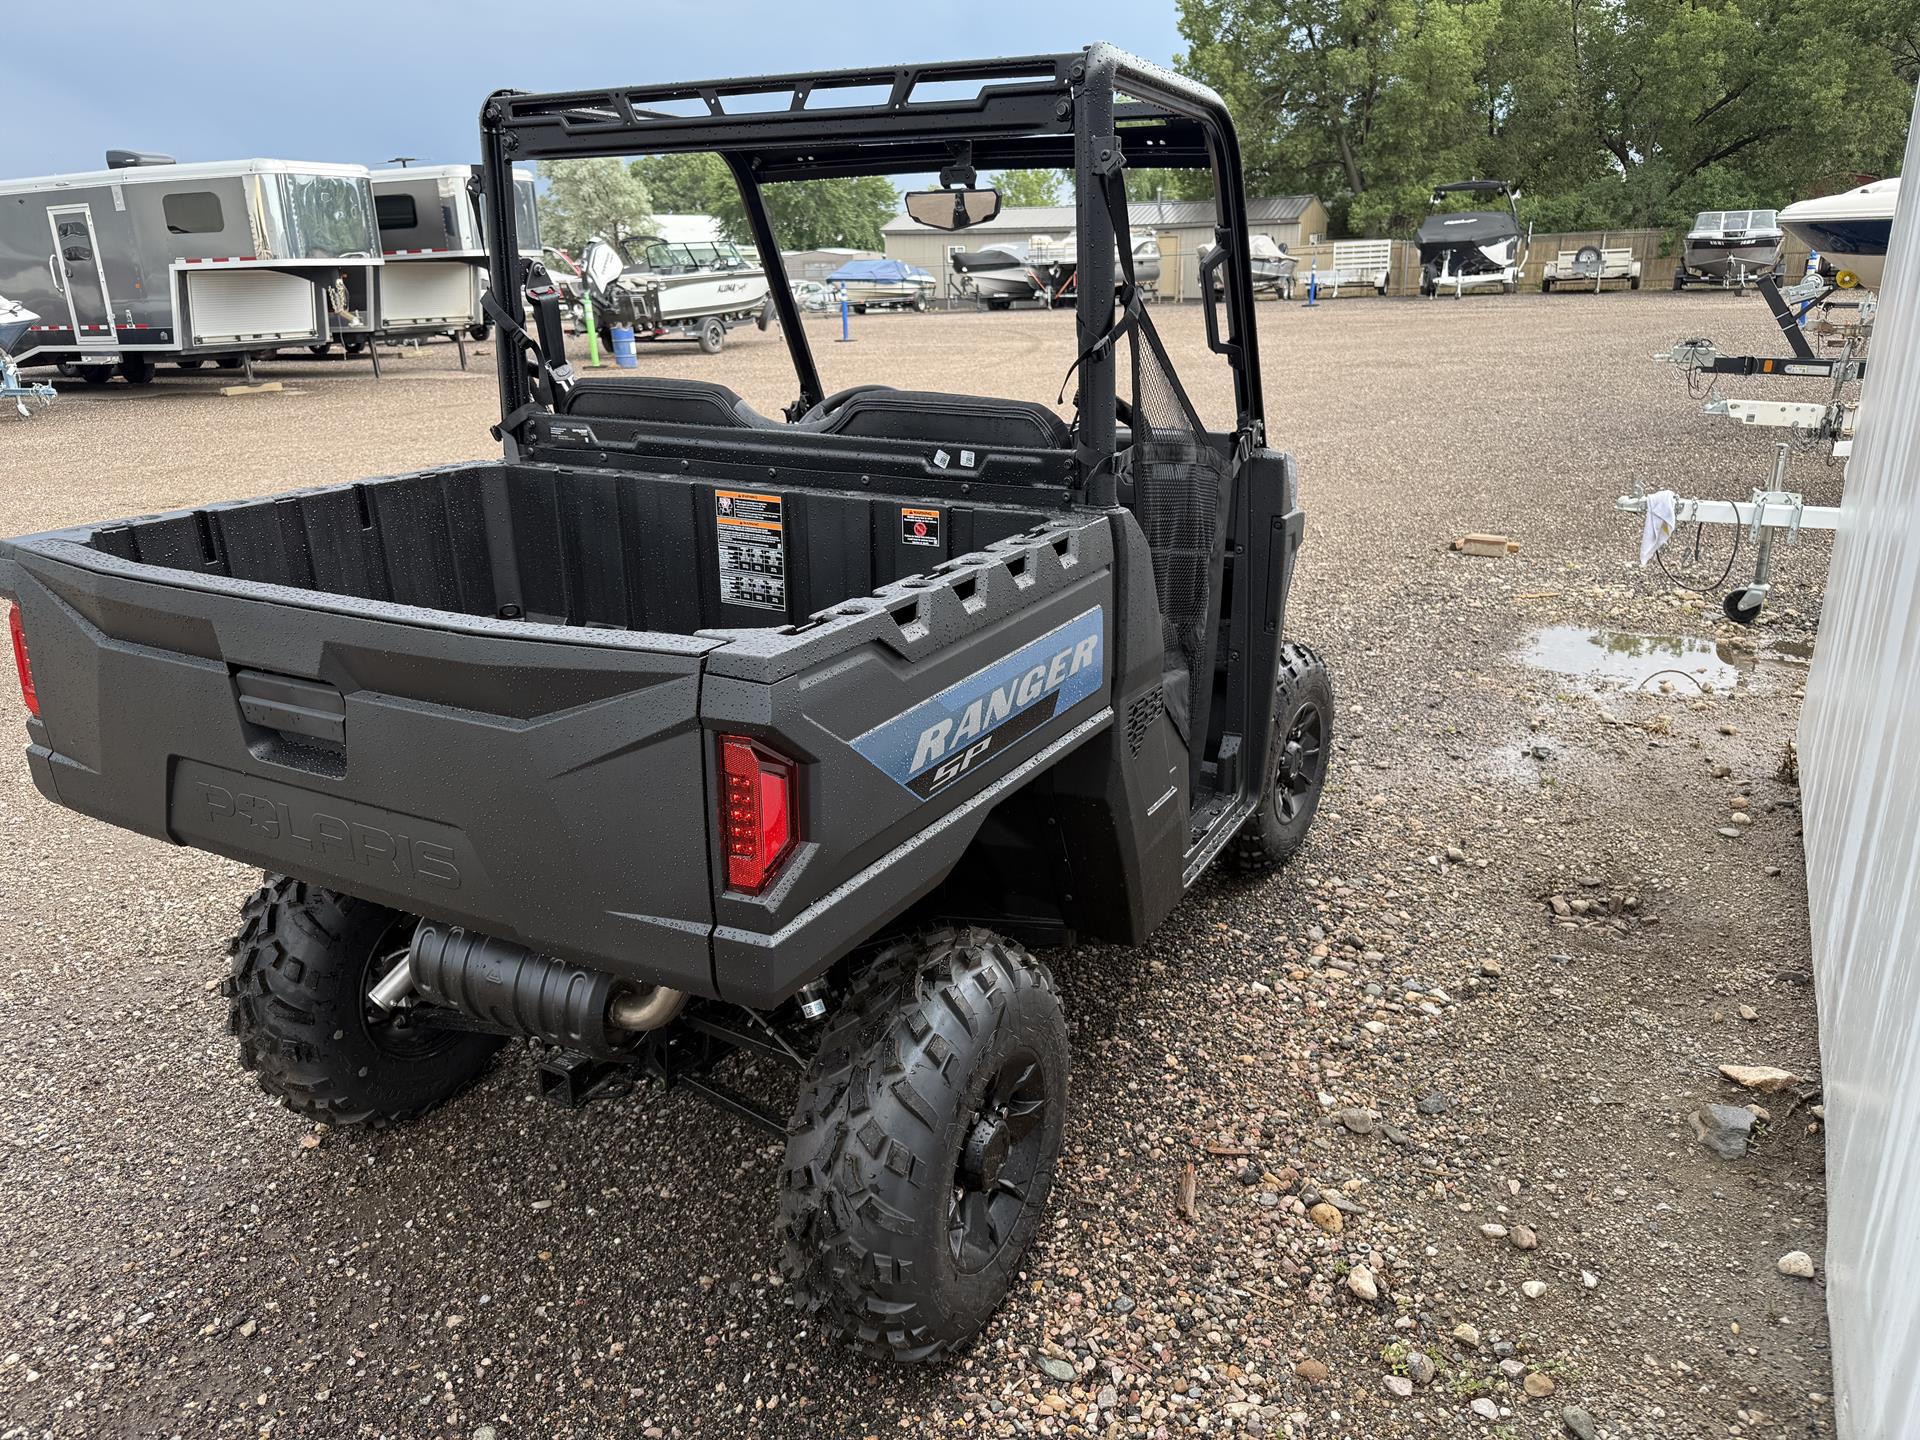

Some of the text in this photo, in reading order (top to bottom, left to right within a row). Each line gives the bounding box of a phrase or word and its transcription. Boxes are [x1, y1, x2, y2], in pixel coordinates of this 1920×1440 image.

[909, 634, 1098, 774] RANGER
[929, 736, 992, 791] SP
[195, 781, 462, 889] POLARIS
